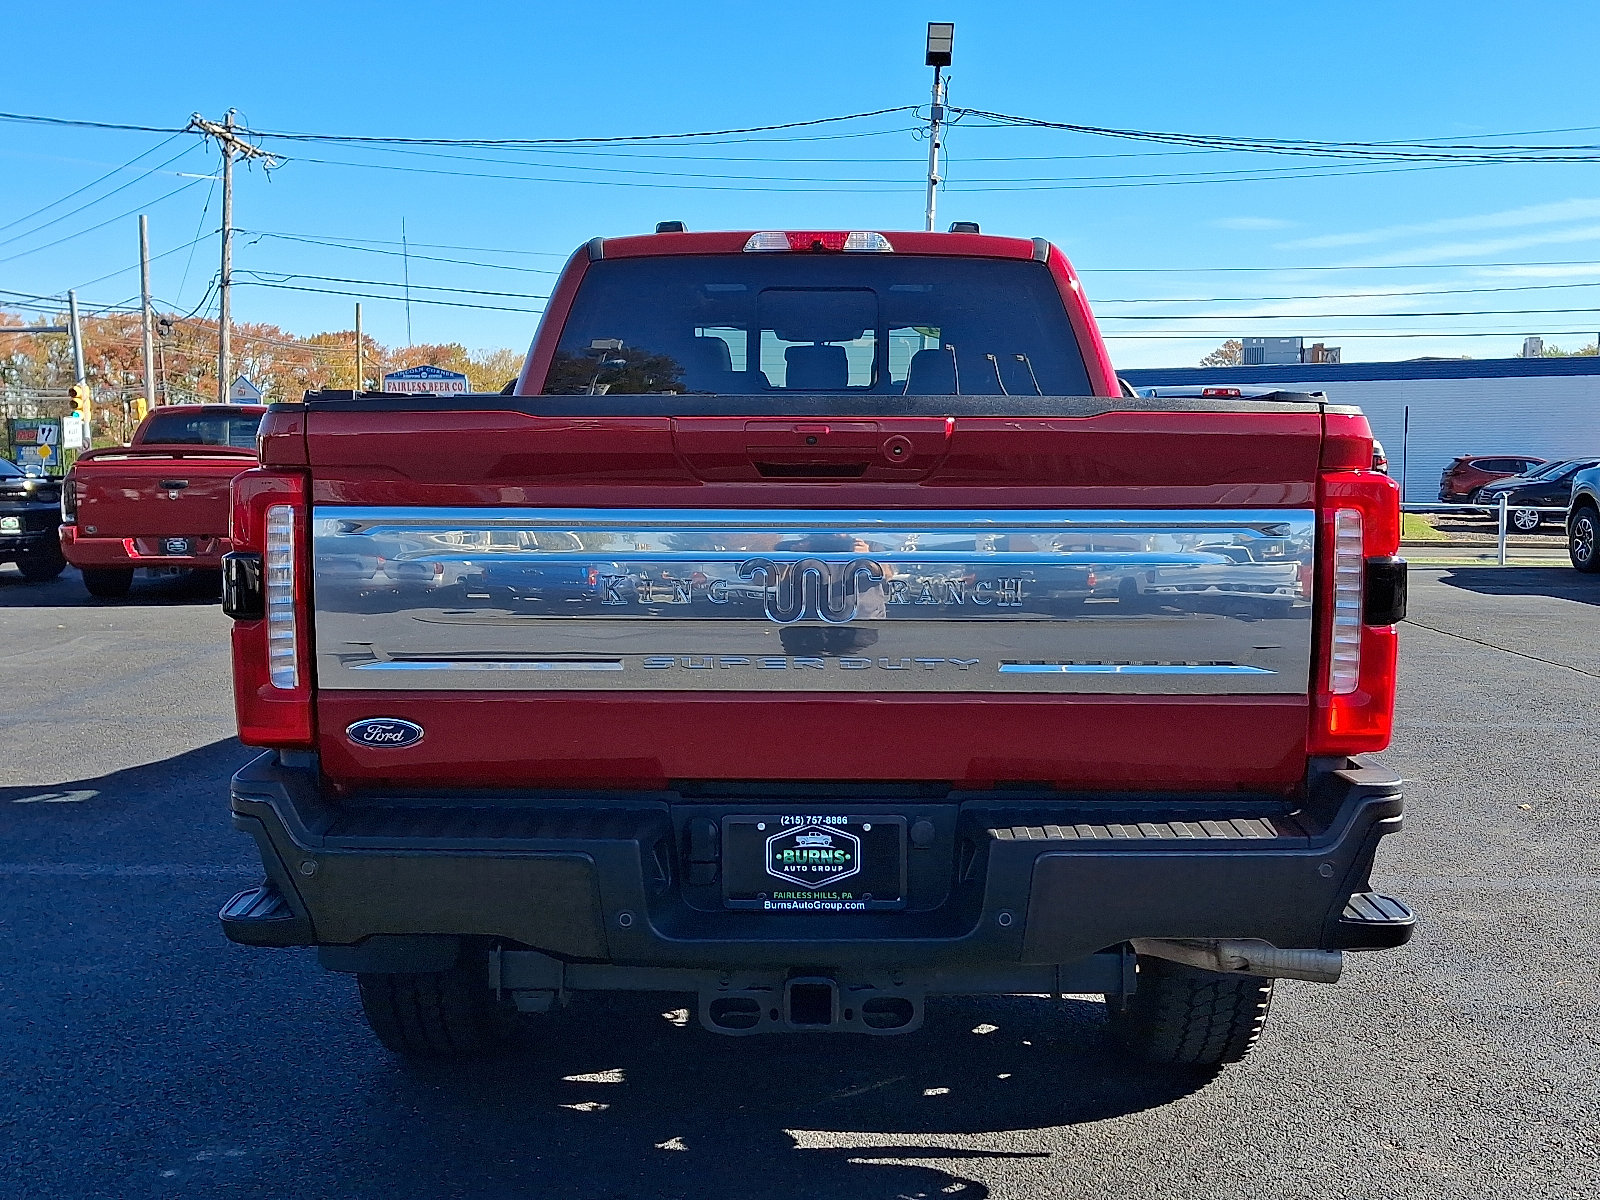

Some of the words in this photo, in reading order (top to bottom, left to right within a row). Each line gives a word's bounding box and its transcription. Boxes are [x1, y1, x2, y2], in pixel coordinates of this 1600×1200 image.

[426, 367, 454, 377] CORNER
[387, 382, 426, 392] FAIRLESS
[429, 382, 449, 392] BEER
[888, 577, 1023, 606] RANCH
[643, 656, 824, 670] SUPER
[839, 656, 979, 671] DUTY
[363, 724, 405, 742] Ford
[780, 815, 804, 826] (215)
[783, 850, 845, 864] BURNS
[773, 891, 812, 900] FAIRLESS
[813, 891, 840, 900] HILLS,
[842, 891, 853, 900] PA
[764, 900, 865, 910] BurnsAutoGroup.com
